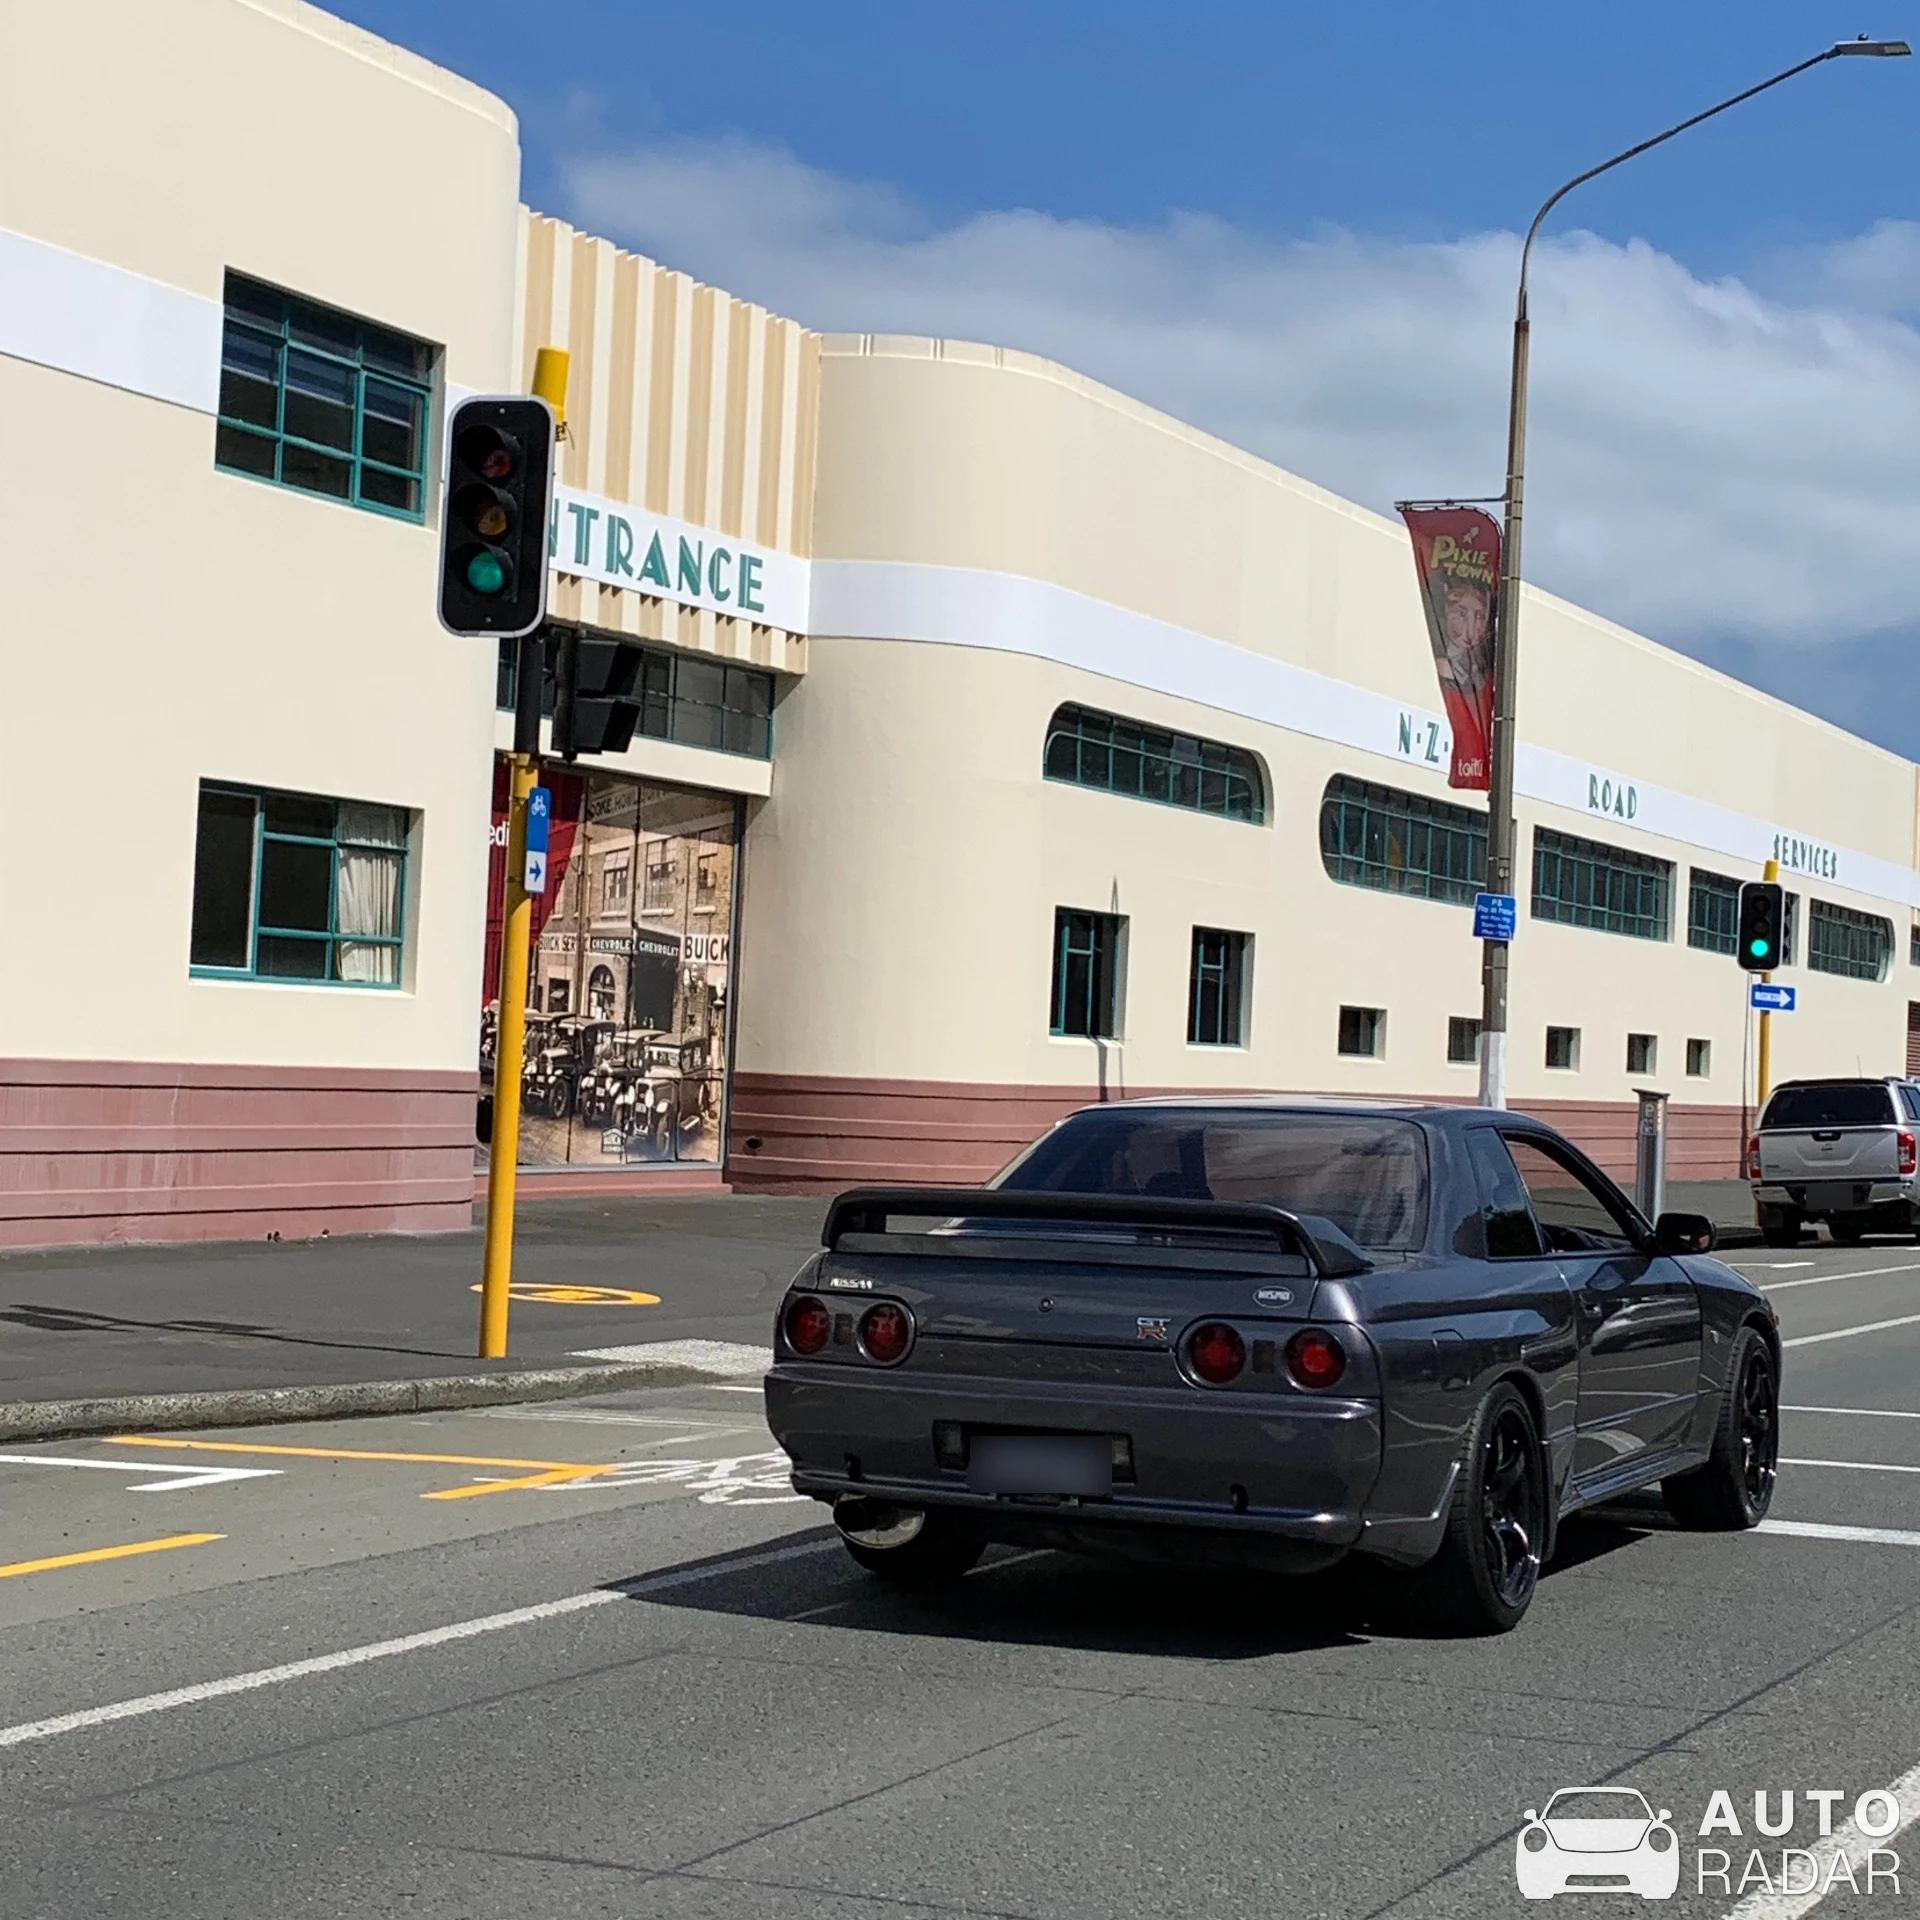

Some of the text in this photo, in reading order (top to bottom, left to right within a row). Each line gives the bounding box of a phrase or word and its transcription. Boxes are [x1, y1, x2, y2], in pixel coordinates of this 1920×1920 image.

[1443, 562, 1493, 585] TOWN
[1588, 773, 1637, 819] ROAD
[1773, 833, 1837, 879] SERVICES
[639, 941, 679, 957] CHEVROLET
[685, 936, 729, 961] BUICK
